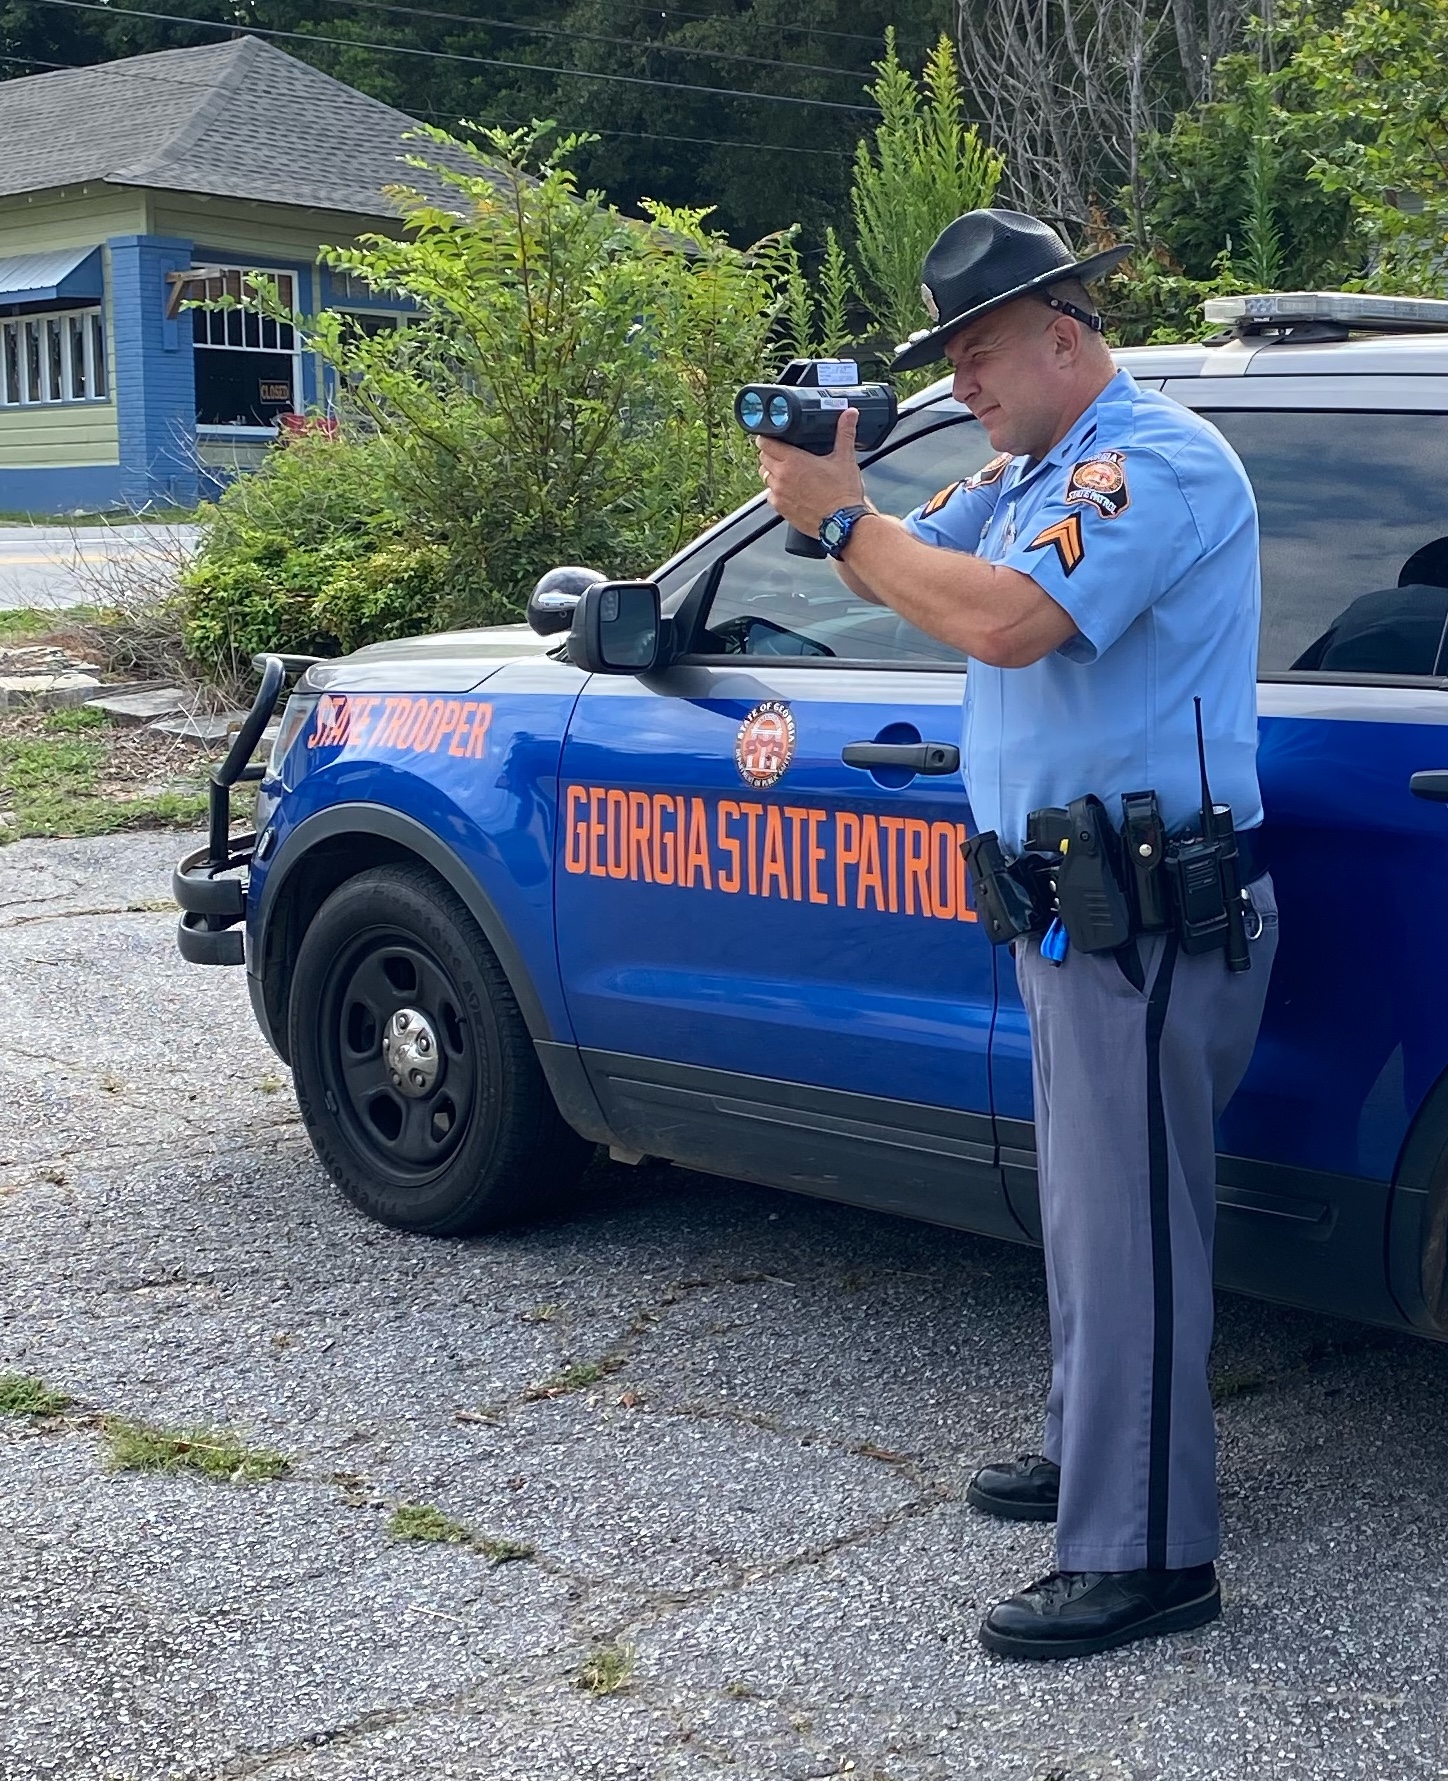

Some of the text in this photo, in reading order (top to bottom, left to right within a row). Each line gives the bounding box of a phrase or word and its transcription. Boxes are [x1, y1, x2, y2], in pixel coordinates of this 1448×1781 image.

[261, 385, 288, 399] CLOSED
[1090, 491, 1118, 516] PATROL
[308, 694, 493, 759] STATE TROOPER
[737, 708, 757, 739] STATE
[760, 702, 772, 712] OF
[773, 703, 794, 743] GEORGIA
[565, 785, 978, 923] GEORGIA STATE PATROL
